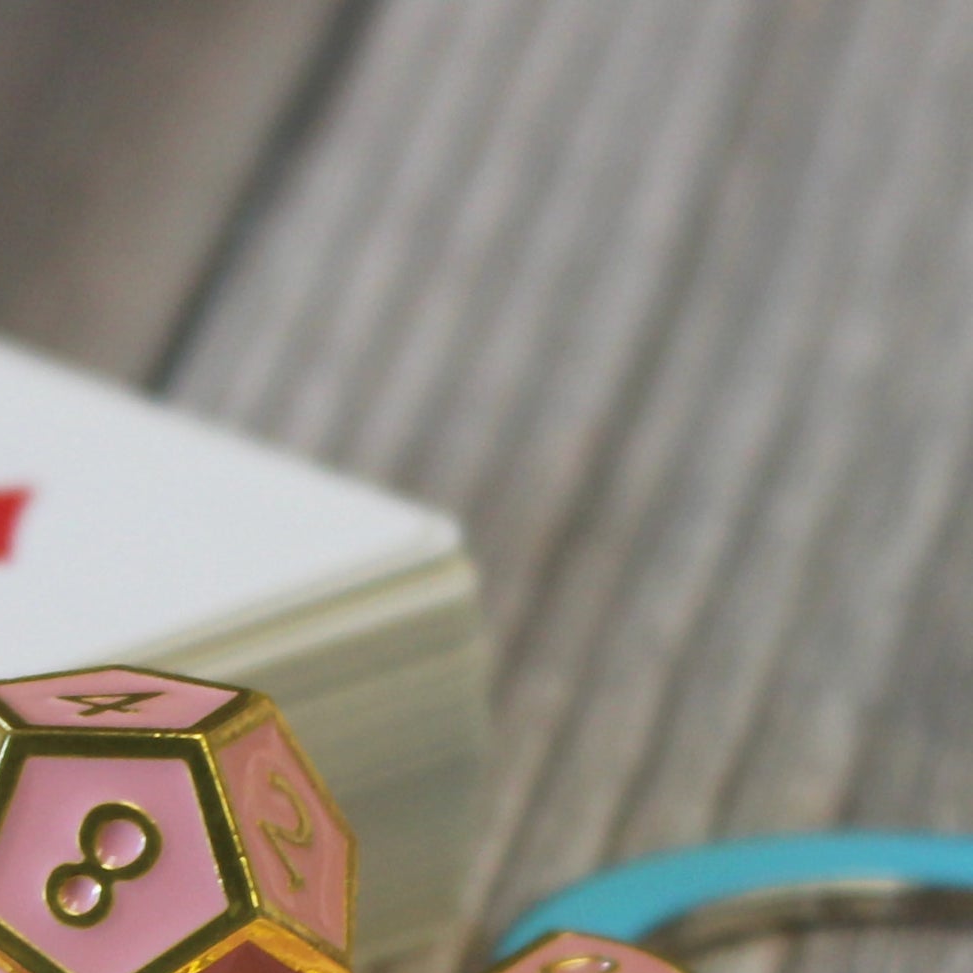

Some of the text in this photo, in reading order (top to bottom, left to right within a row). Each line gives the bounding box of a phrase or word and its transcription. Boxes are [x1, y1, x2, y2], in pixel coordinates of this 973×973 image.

[56, 691, 168, 717] 4
[45, 802, 163, 929] 8
[258, 771, 314, 889] 2
